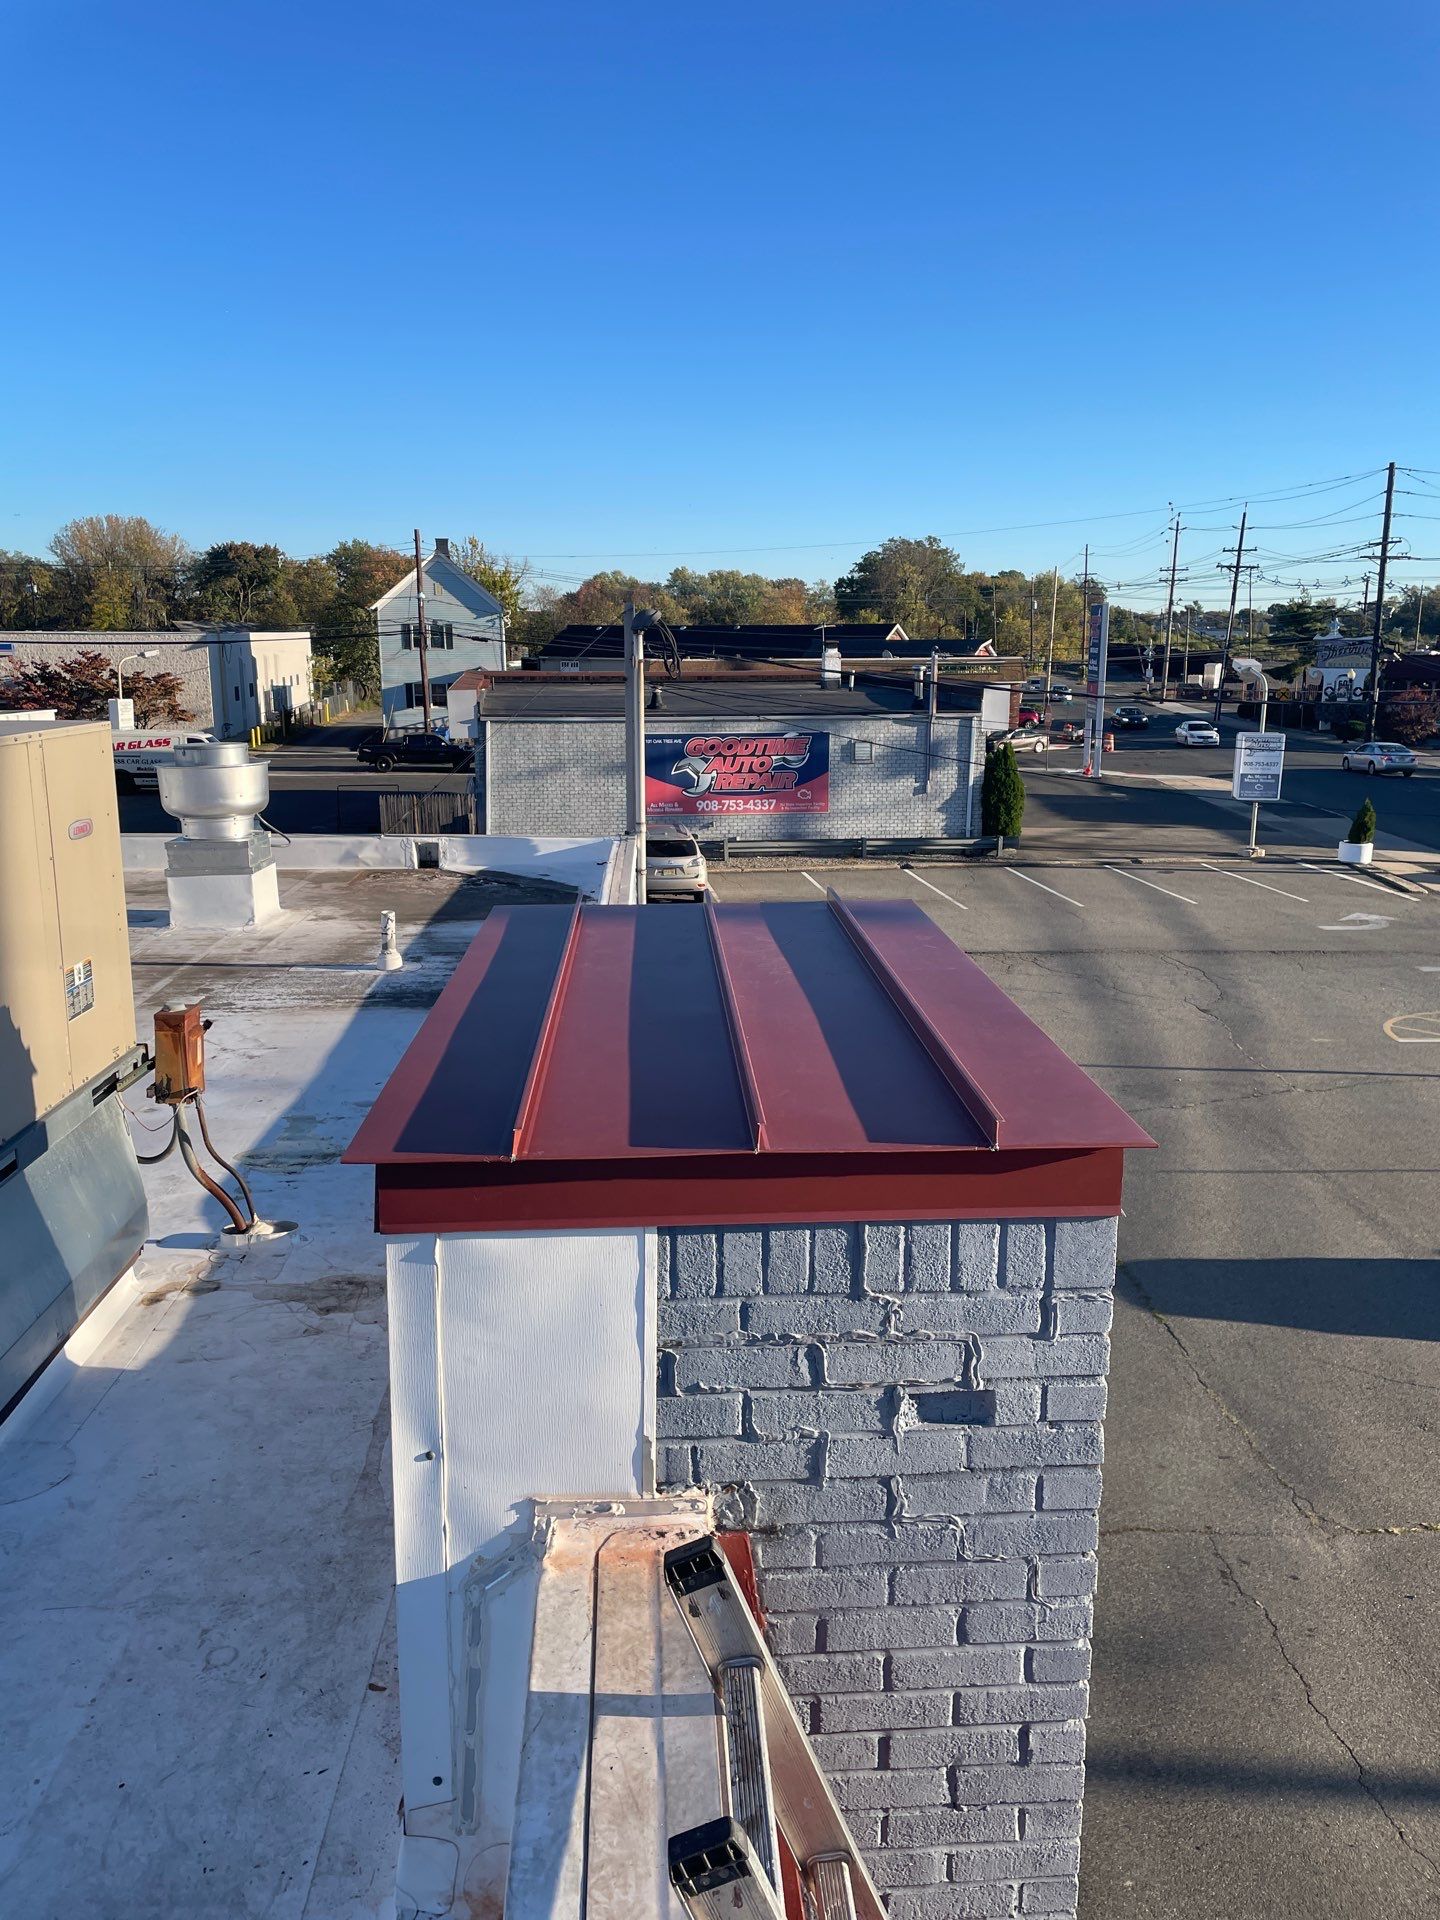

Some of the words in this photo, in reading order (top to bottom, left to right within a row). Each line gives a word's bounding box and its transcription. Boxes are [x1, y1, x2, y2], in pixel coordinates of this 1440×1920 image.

[128, 738, 171, 750] GLASS
[687, 738, 809, 756] GOODTIME
[703, 756, 773, 773] AUTO
[713, 772, 796, 789] REPAIR
[696, 799, 777, 812] 908-753-4337
